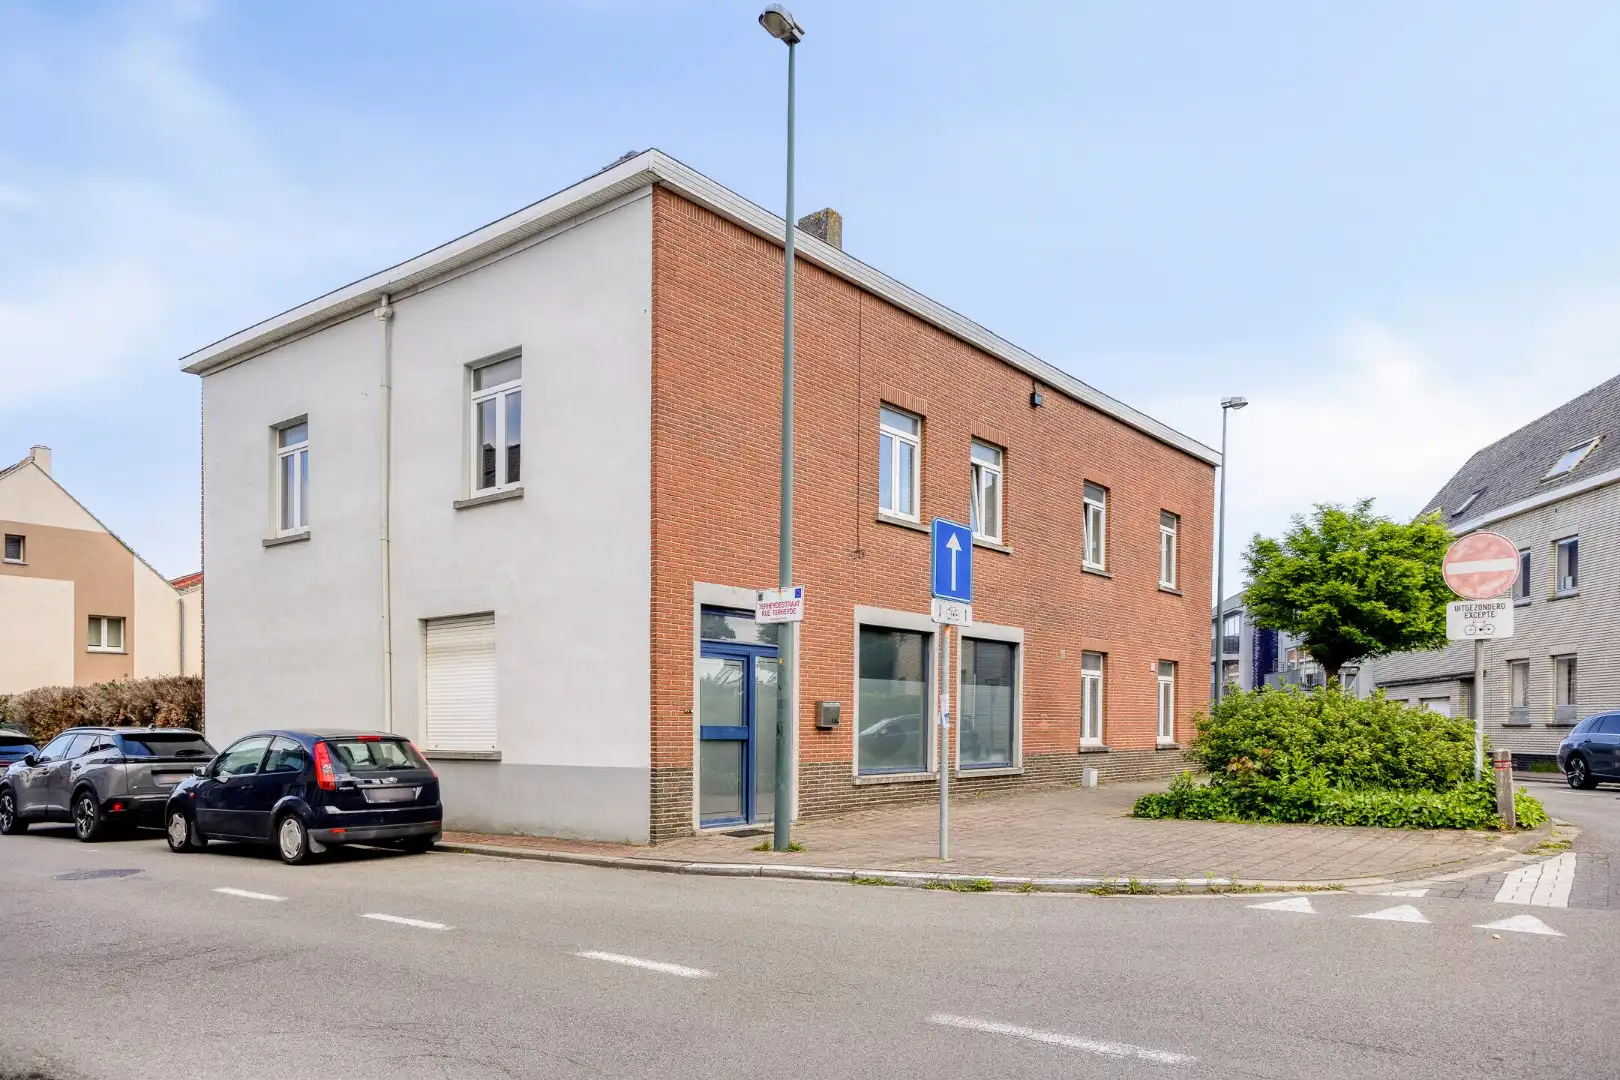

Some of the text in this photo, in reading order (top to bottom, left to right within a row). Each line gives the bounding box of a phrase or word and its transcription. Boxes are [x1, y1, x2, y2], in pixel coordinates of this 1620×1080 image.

[759, 600, 800, 610] TERHEYDESTRAAT
[1454, 603, 1506, 611] UITGEZONDERD
[761, 607, 797, 617] RUE TERHEYDE
